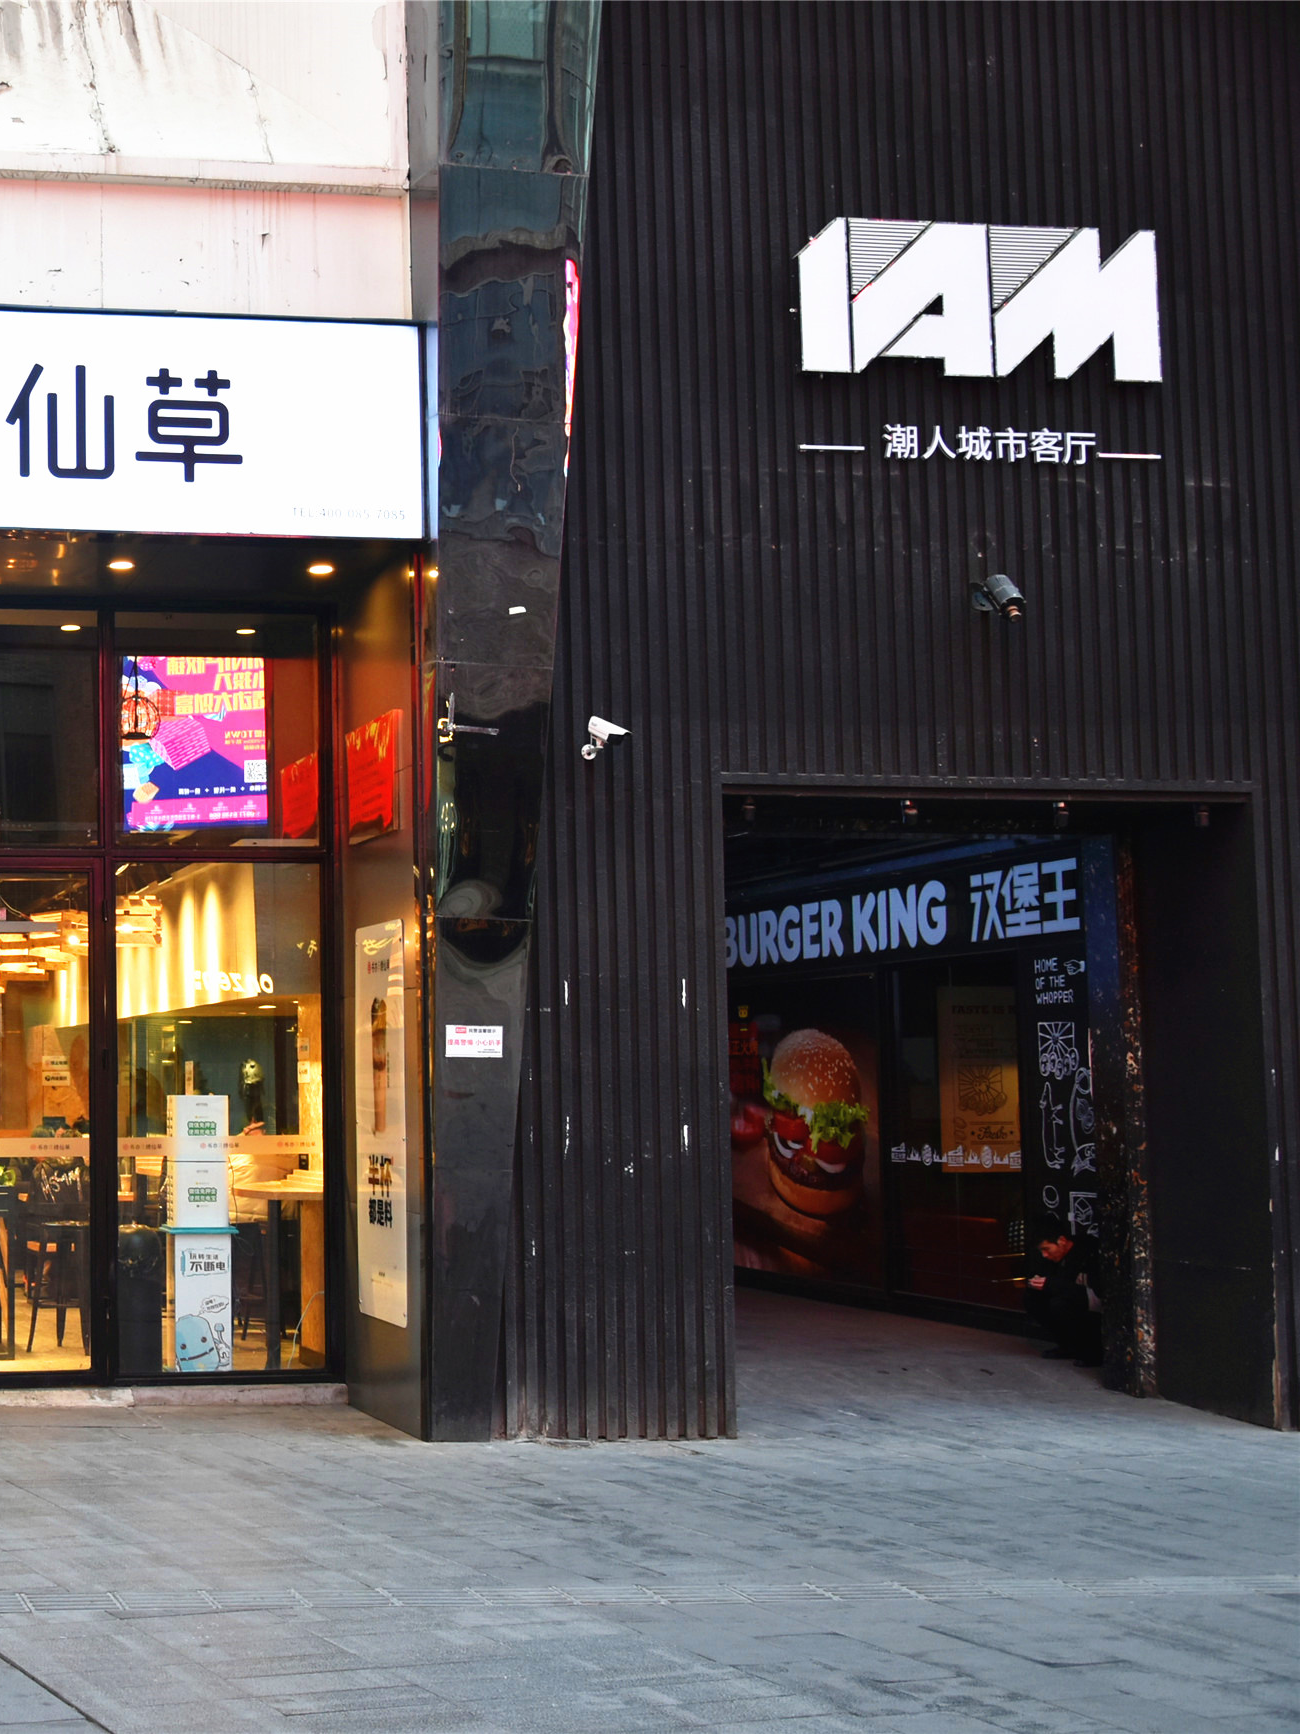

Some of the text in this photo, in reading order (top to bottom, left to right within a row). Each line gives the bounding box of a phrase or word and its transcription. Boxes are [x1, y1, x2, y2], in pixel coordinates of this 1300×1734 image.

[883, 424, 1096, 464] 潮人城市客厅
[970, 857, 1081, 943] 汉堡王
[724, 879, 947, 968] BURGER KING
[1034, 957, 1059, 975] HOME
[1035, 974, 1066, 991] OF THE
[1035, 988, 1074, 1005] WHOPPER
[368, 1154, 393, 1198] 半杯
[368, 1198, 393, 1229] 都是料
[189, 1261, 226, 1272] 不断电
